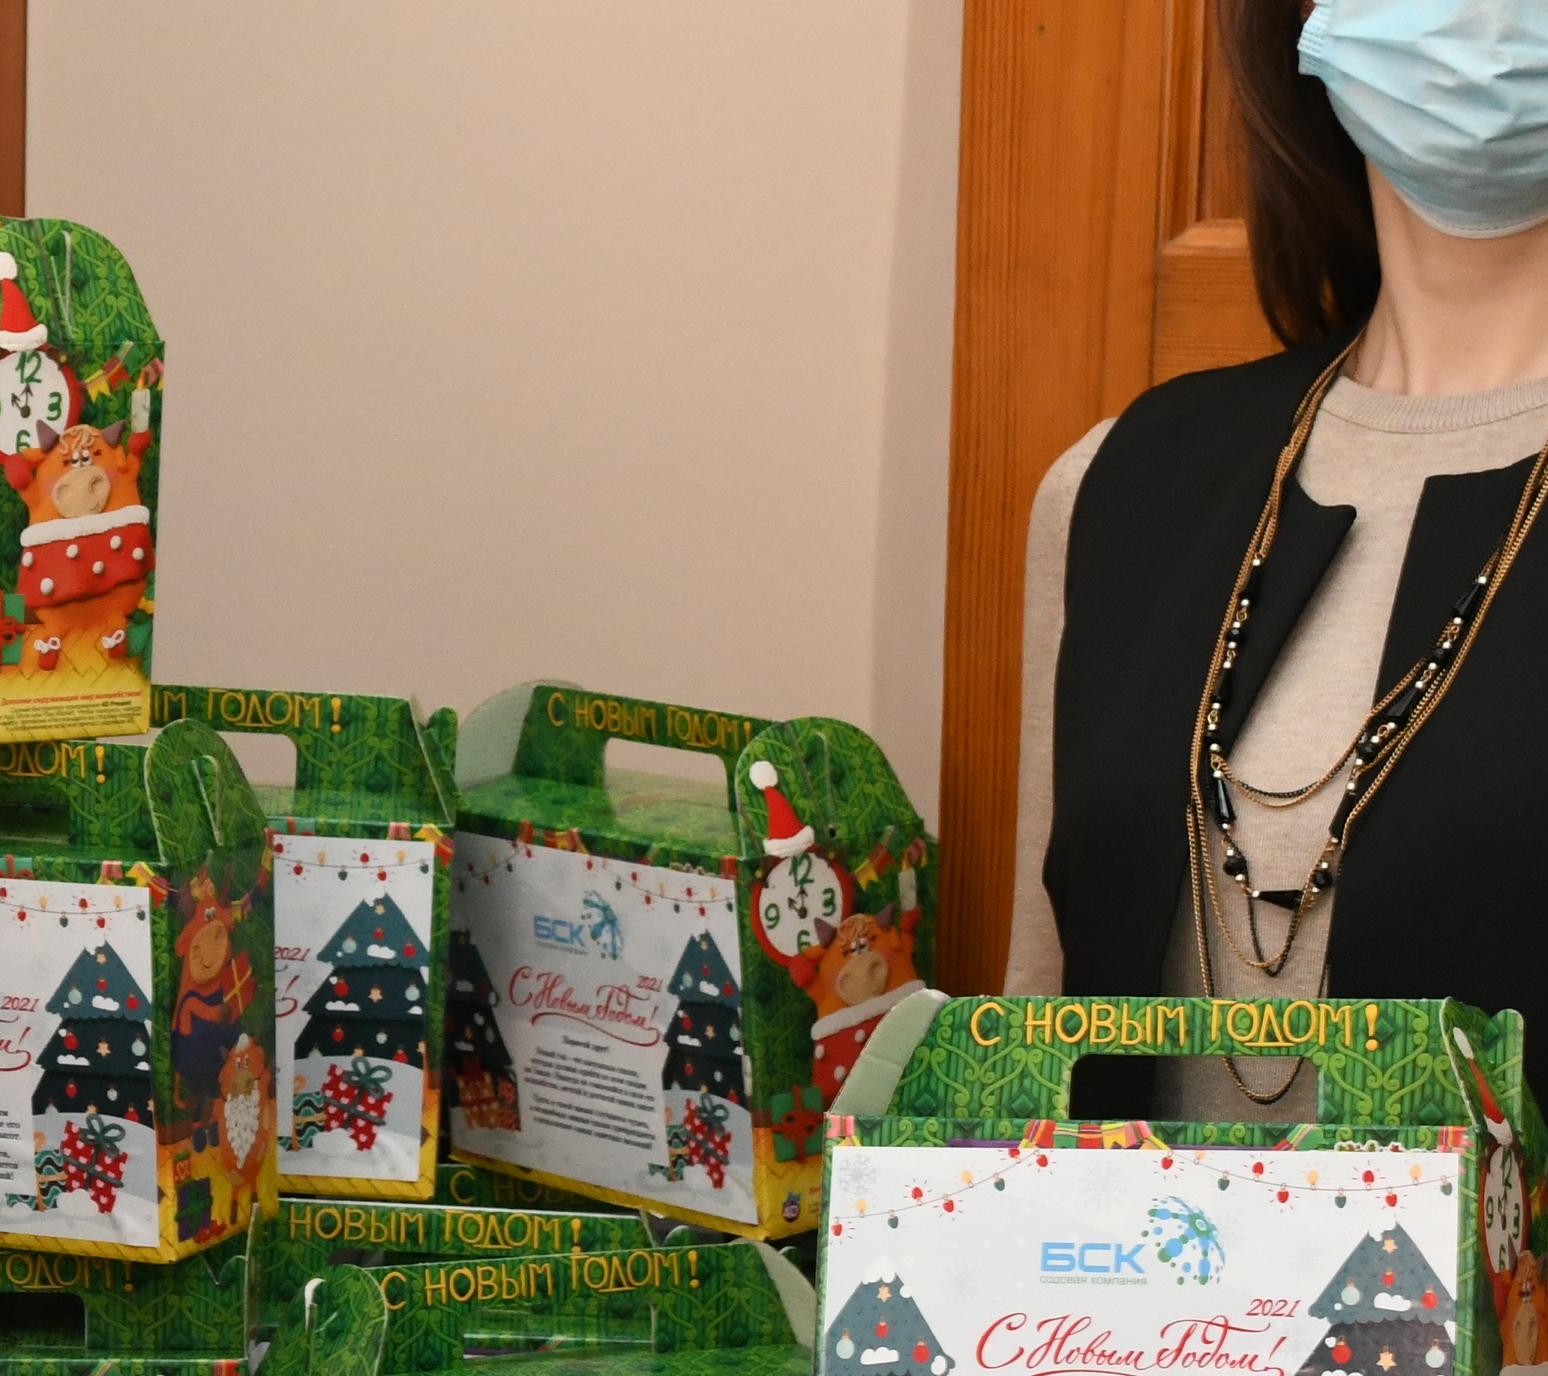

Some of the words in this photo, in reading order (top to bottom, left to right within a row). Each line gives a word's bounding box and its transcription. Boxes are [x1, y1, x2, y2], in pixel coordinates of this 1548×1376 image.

[208, 688, 342, 733] ГОДОМ!
[548, 692, 567, 726] С
[576, 698, 656, 733] НОВЫМ
[666, 704, 753, 750] ГОДОМ!
[534, 915, 584, 944] БСК
[0, 995, 40, 1013] 2021
[509, 966, 535, 1009] С
[534, 968, 592, 1016] Новым
[596, 984, 657, 1028] Годом!
[971, 1002, 1006, 1047] С
[1025, 1003, 1189, 1046] НОВЫМ
[1210, 999, 1380, 1051] ГОДОМ!
[290, 1206, 426, 1245] НОВЫМ
[445, 1208, 583, 1254] ГОДОМ!
[381, 1271, 407, 1311] С
[424, 1263, 554, 1306] НОВЫМ
[571, 1248, 701, 1293] ГОДОМ!
[1040, 1241, 1147, 1274] БСК
[1039, 1275, 1088, 1288] содовая
[1090, 1276, 1148, 1288] компания
[1245, 1297, 1301, 1319] 2021
[975, 1311, 1027, 1371] С
[1026, 1314, 1158, 1372] Новым
[1156, 1314, 1289, 1374] Годом!
